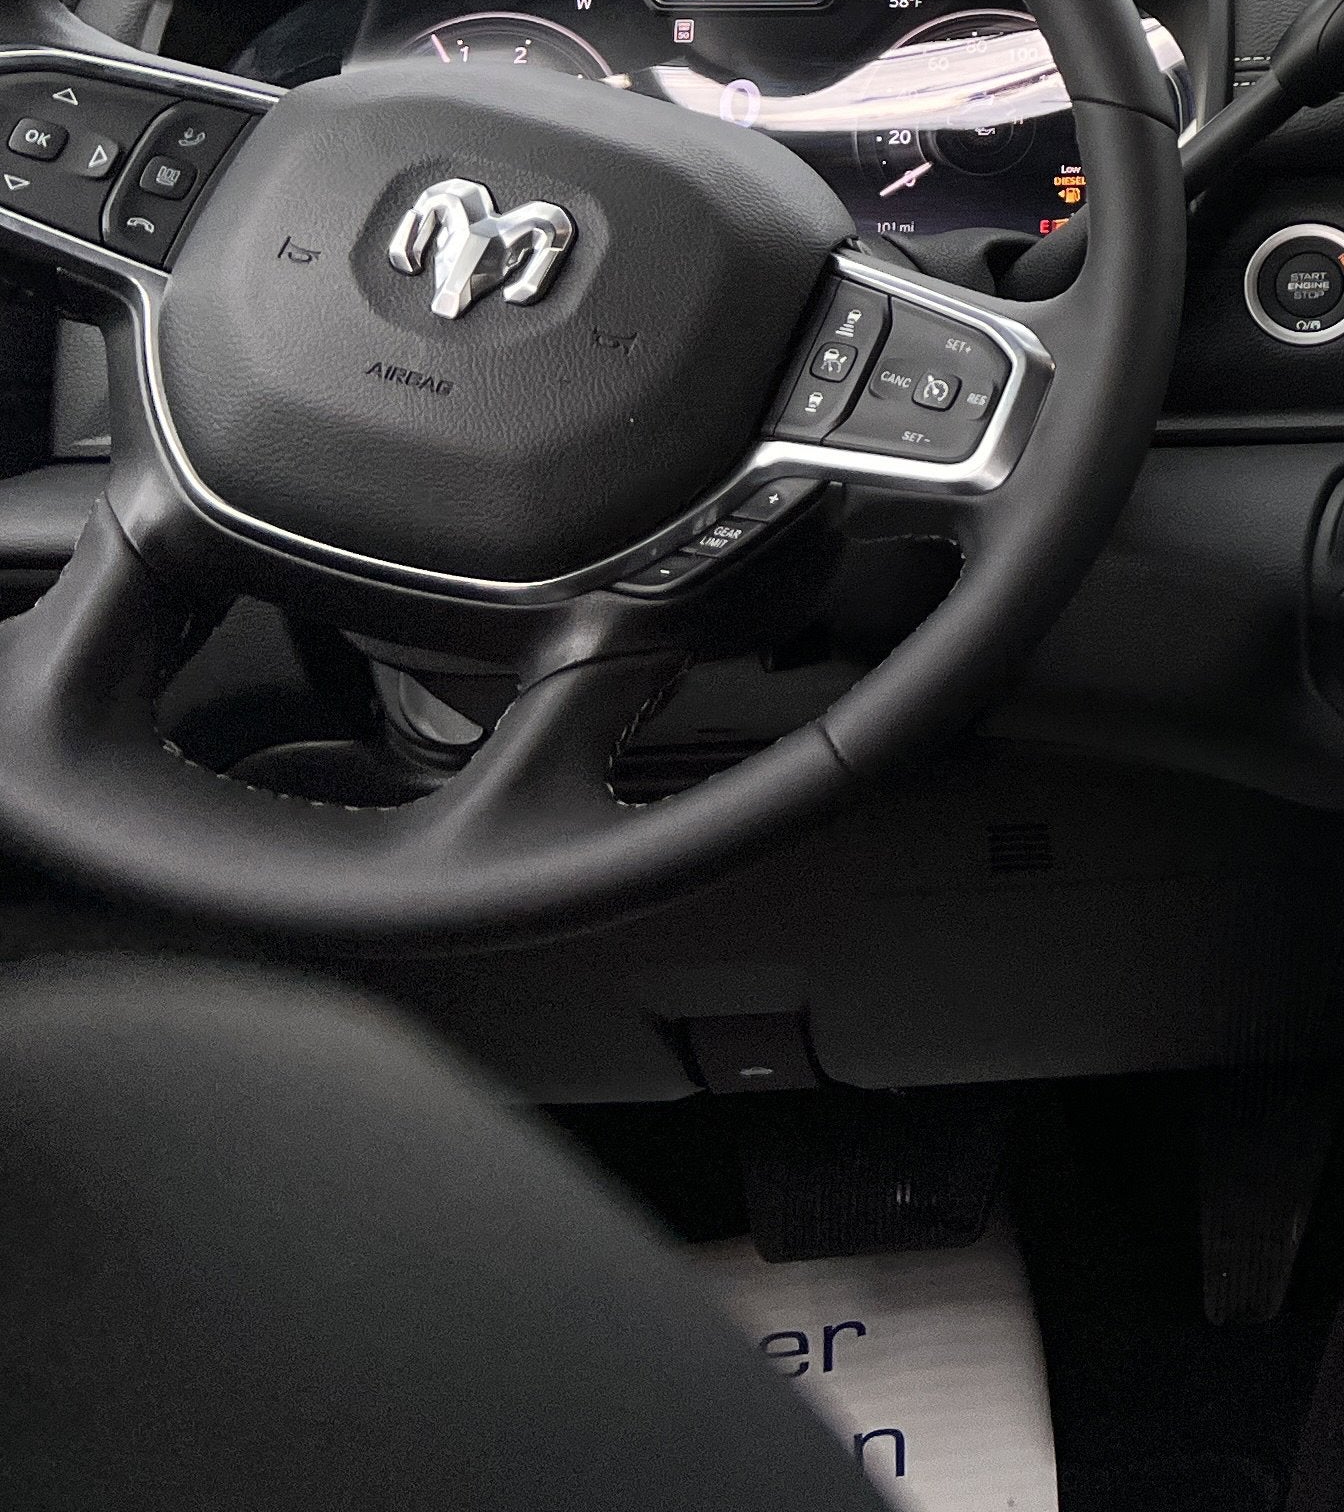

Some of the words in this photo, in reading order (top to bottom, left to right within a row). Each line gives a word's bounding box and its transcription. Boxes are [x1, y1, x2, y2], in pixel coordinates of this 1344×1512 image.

[460, 45, 470, 62] 1
[514, 46, 528, 64] 2
[25, 129, 50, 147] OK
[888, 129, 911, 145] 20
[1060, 165, 1080, 174] Low
[1053, 176, 1086, 187] DIESEL
[1039, 219, 1049, 233] E
[1290, 271, 1328, 281] START
[1287, 281, 1330, 291] ENGINE
[1293, 290, 1325, 299] STOP
[364, 361, 455, 396] AIRBAG
[881, 370, 912, 388] CANC
[966, 392, 988, 406] RES
[713, 525, 742, 540] GEAR
[700, 535, 729, 548] LIMIT
